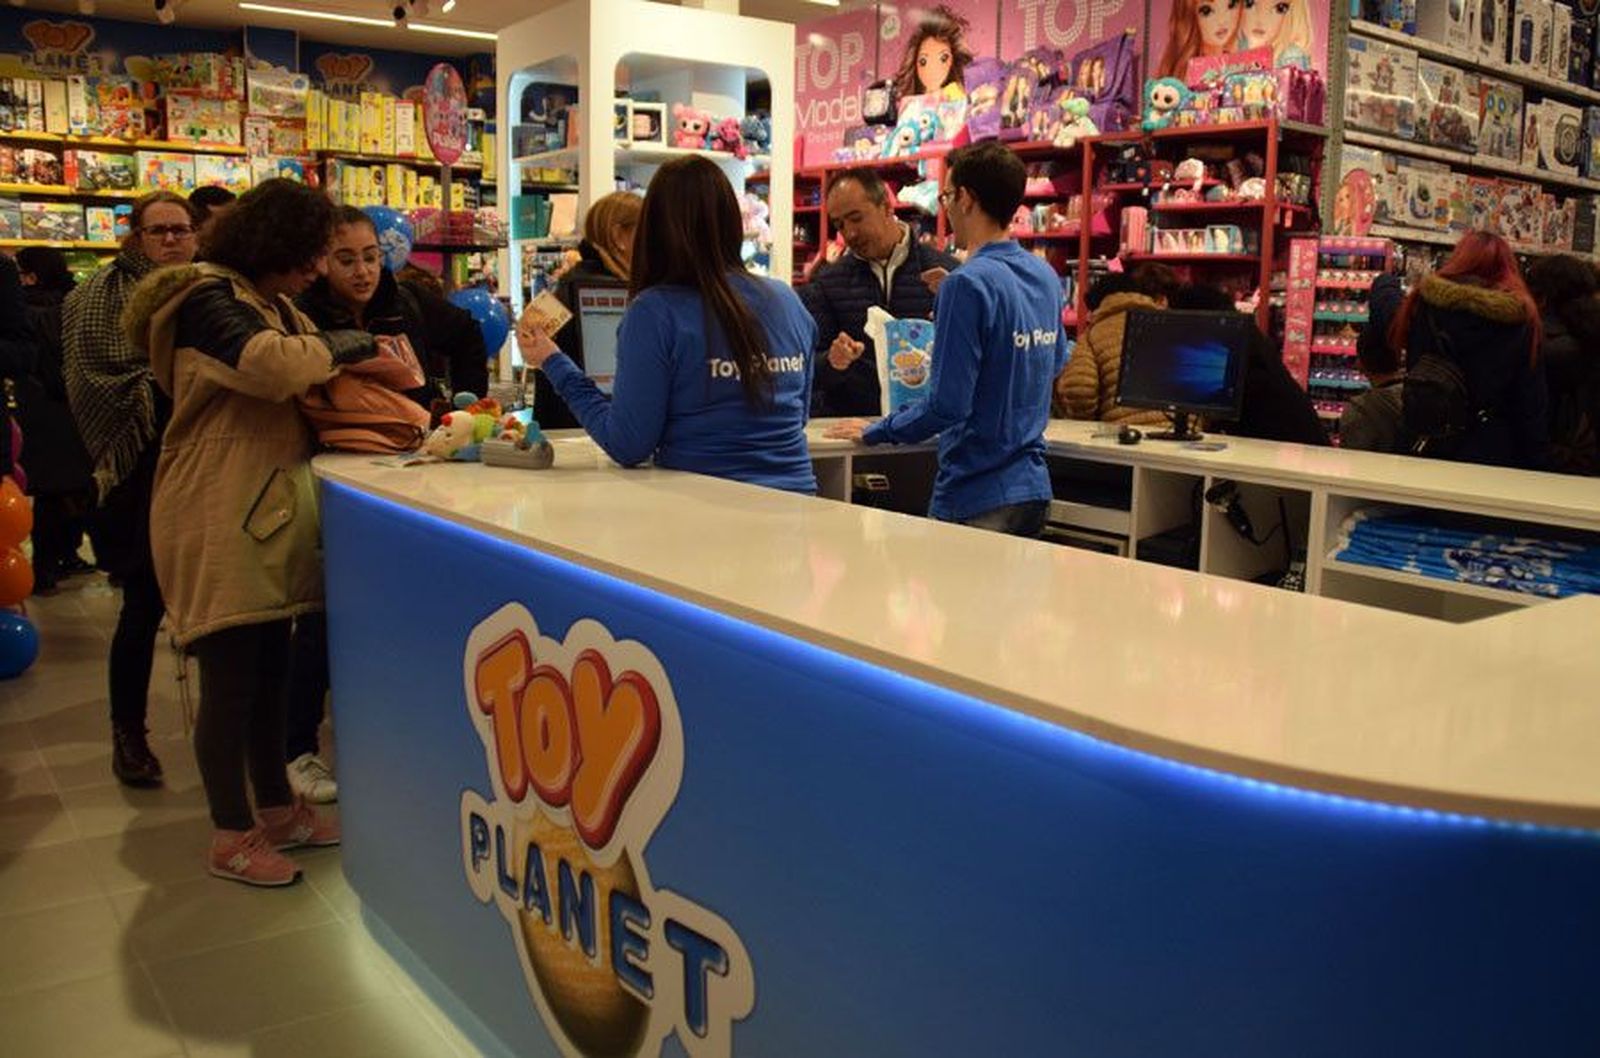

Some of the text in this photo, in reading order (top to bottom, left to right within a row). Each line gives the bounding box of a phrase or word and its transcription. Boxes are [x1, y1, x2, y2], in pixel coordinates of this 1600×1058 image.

[796, 85, 862, 128] Model
[475, 629, 661, 850] TOY
[469, 812, 730, 1039] PLANET
